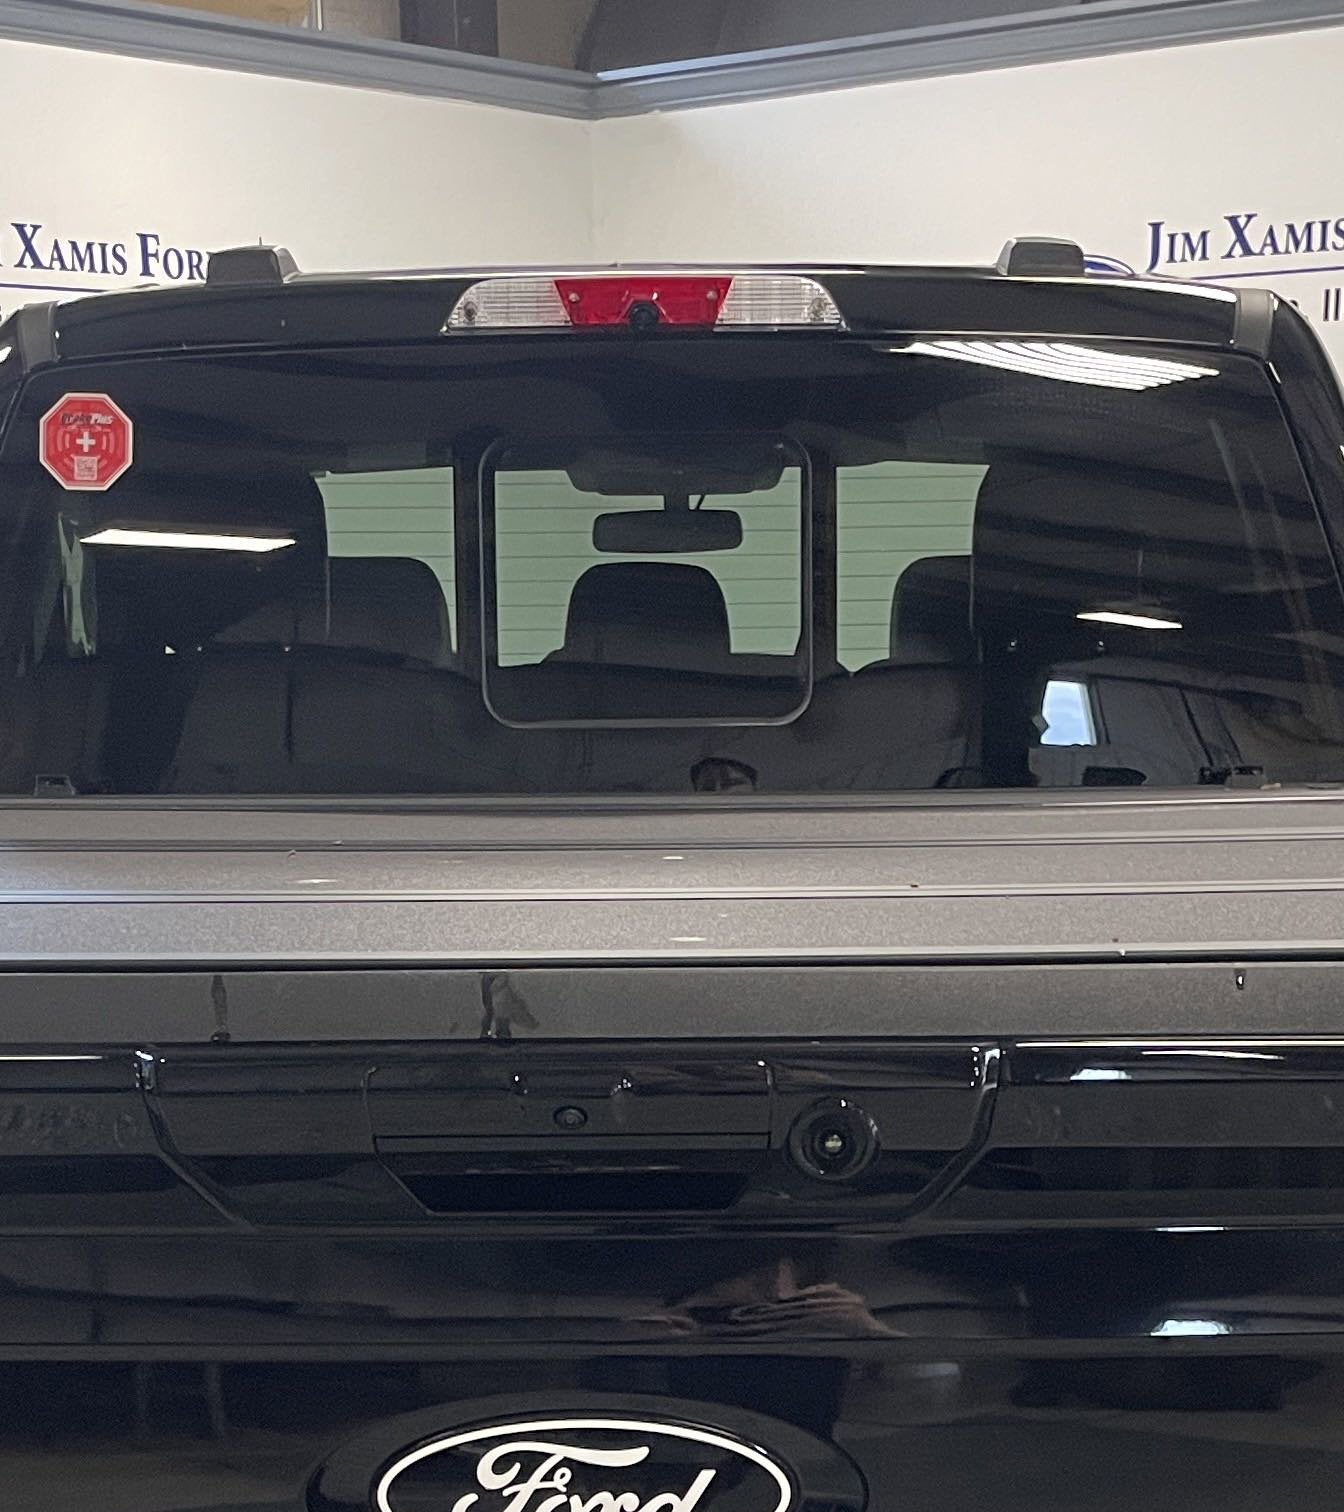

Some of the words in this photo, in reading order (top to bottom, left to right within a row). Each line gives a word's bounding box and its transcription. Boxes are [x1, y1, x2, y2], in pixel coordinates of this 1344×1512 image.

[11, 222, 128, 276] XAMIS
[136, 232, 209, 281] FOR
[1145, 220, 1211, 273] JIM
